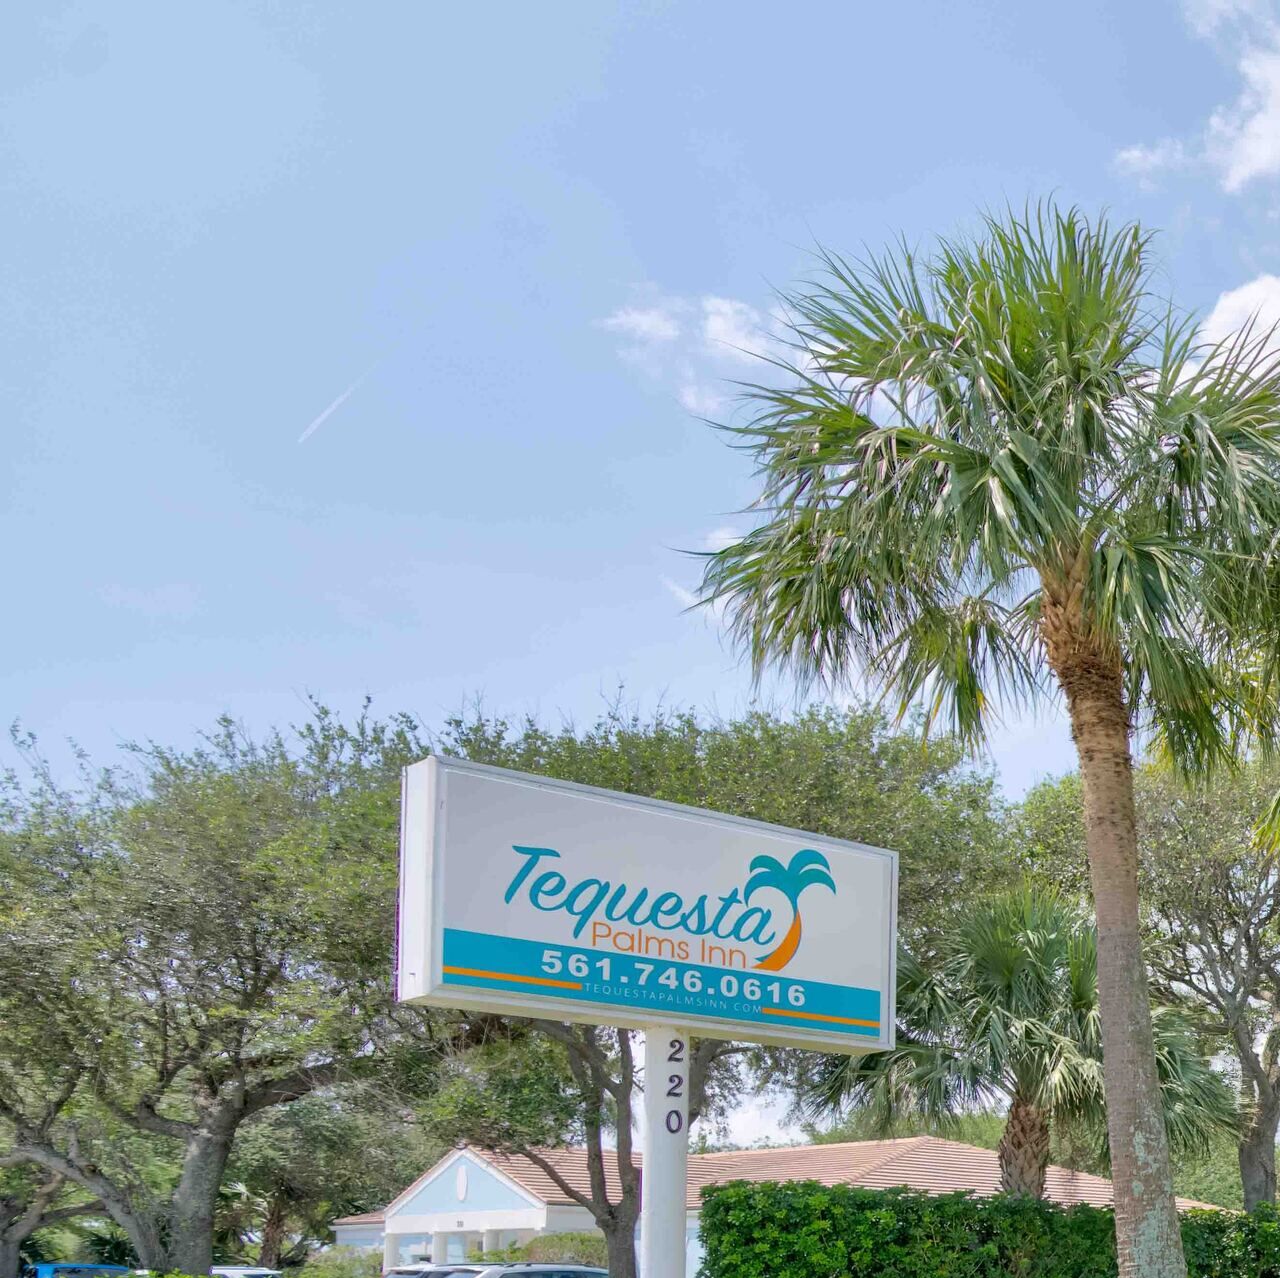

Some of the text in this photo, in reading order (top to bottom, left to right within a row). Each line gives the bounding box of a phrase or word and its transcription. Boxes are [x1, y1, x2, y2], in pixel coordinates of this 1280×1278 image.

[504, 845, 776, 945] Tequesta
[592, 922, 747, 968] Palms Inn
[541, 950, 806, 1006] 561.746.0616
[585, 982, 762, 1014] TEQUESTAPALMSINNCOM
